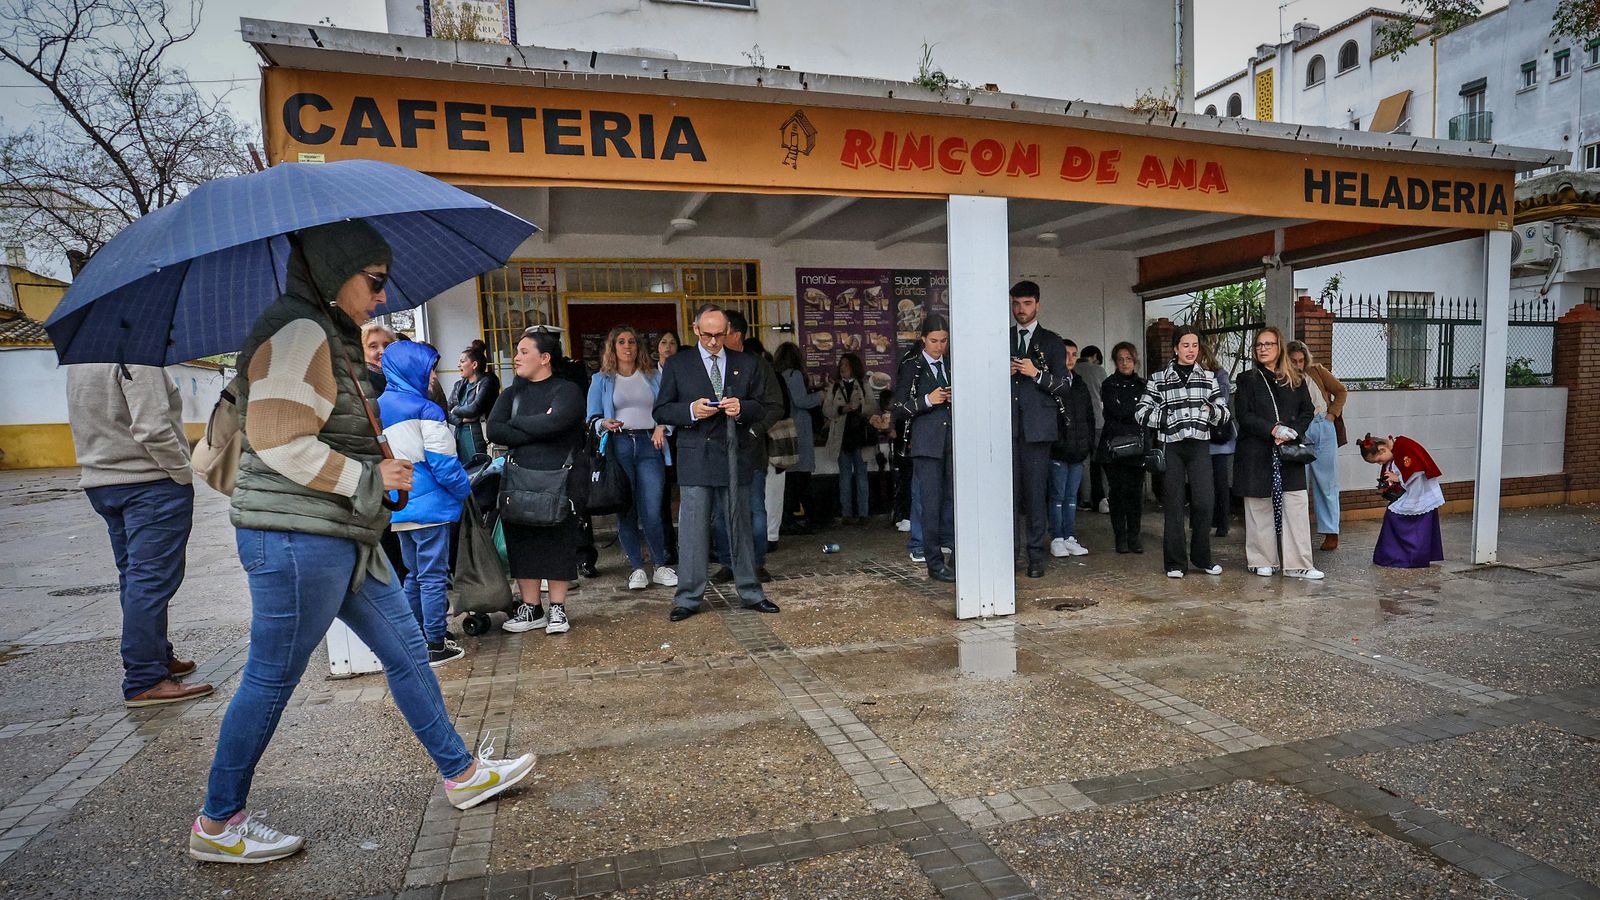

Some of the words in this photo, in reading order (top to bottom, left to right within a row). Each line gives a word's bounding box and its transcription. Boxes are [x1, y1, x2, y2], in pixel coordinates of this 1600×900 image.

[282, 92, 707, 162] CAFETERIA
[840, 128, 1040, 179] RINCON
[1059, 145, 1121, 184] DE
[1136, 155, 1229, 194] ANA
[1304, 168, 1508, 215] HELADERIA
[894, 276, 922, 287] super
[895, 286, 927, 296] ofertas
